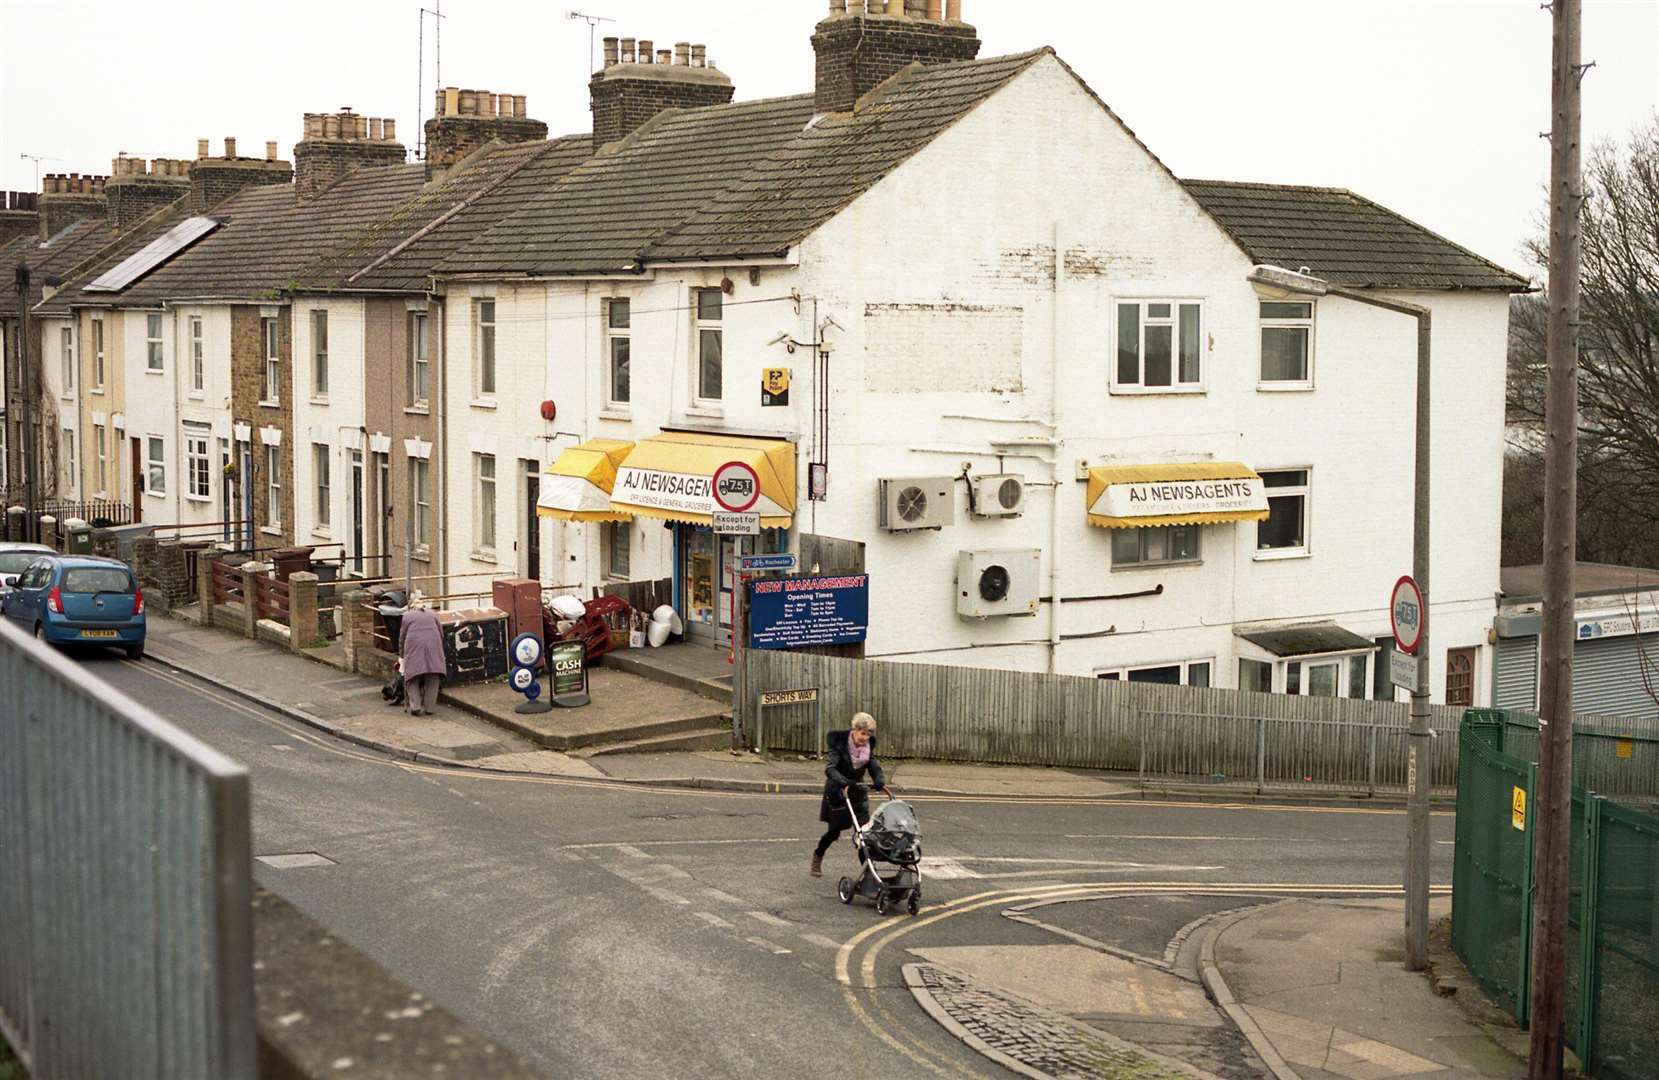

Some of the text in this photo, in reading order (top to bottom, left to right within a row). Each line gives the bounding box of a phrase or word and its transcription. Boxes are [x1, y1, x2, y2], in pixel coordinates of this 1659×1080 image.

[624, 471, 712, 497] AJ NEWSAGEN
[1130, 483, 1252, 502] AJ NEWSAGENTS
[717, 515, 756, 524] Except for
[755, 576, 866, 593] NEW MANAGEMENT
[787, 593, 813, 601] Opening
[555, 659, 582, 671] CASH
[555, 669, 581, 677] MACHINE
[765, 690, 813, 704] SHORTS WAY
